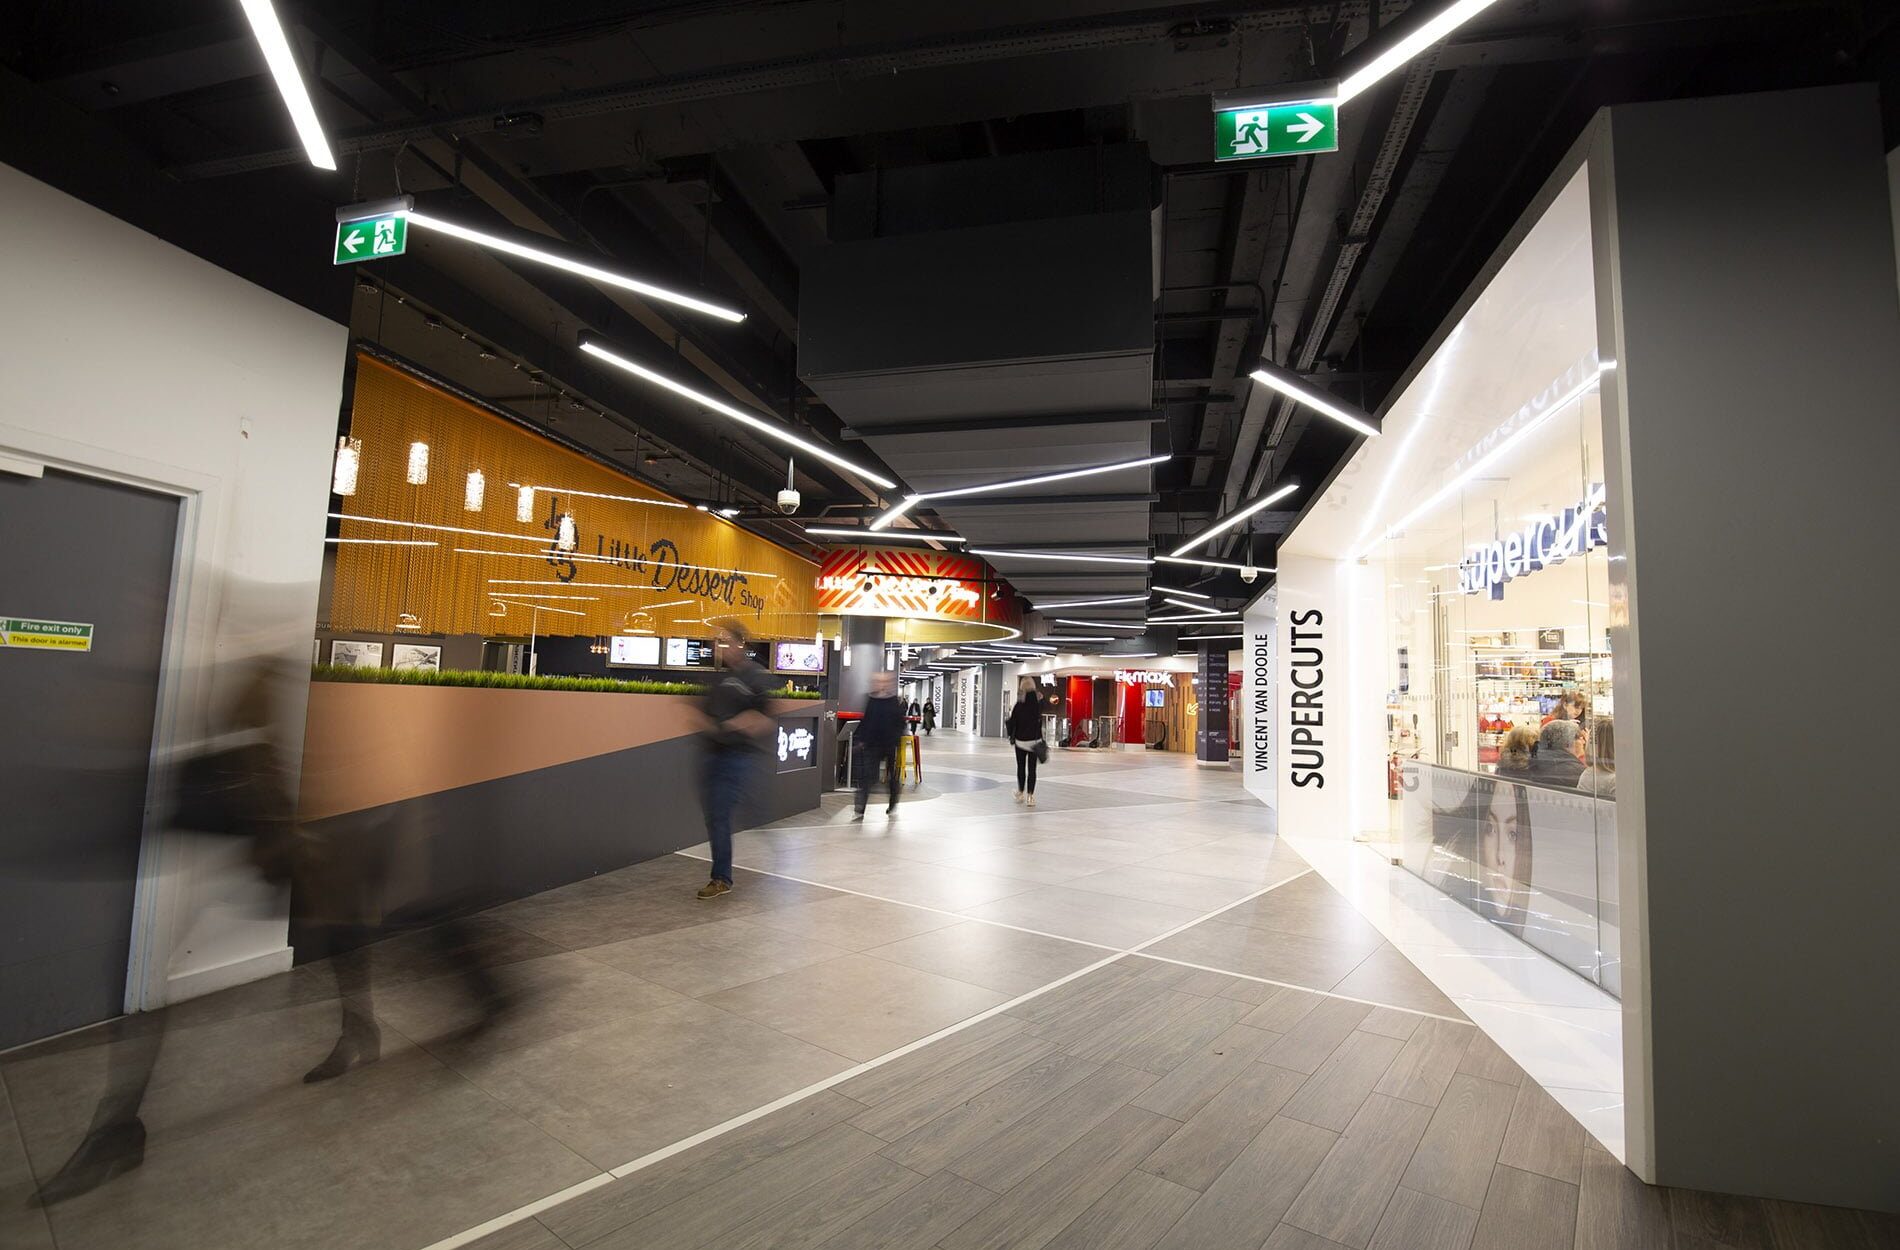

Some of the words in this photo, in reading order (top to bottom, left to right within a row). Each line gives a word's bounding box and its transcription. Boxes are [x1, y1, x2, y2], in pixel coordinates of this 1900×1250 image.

[597, 534, 648, 574] Little
[650, 538, 748, 605] Dessert
[740, 589, 765, 620] Shop
[20, 622, 40, 631] Fire
[41, 624, 60, 633] exit
[62, 625, 82, 636] only
[30, 636, 48, 644] door
[1255, 634, 1268, 686] DOODLE
[1255, 690, 1268, 715] VAN
[1290, 609, 1325, 789] SUPERCUTS
[1255, 717, 1268, 772] VINCENT
